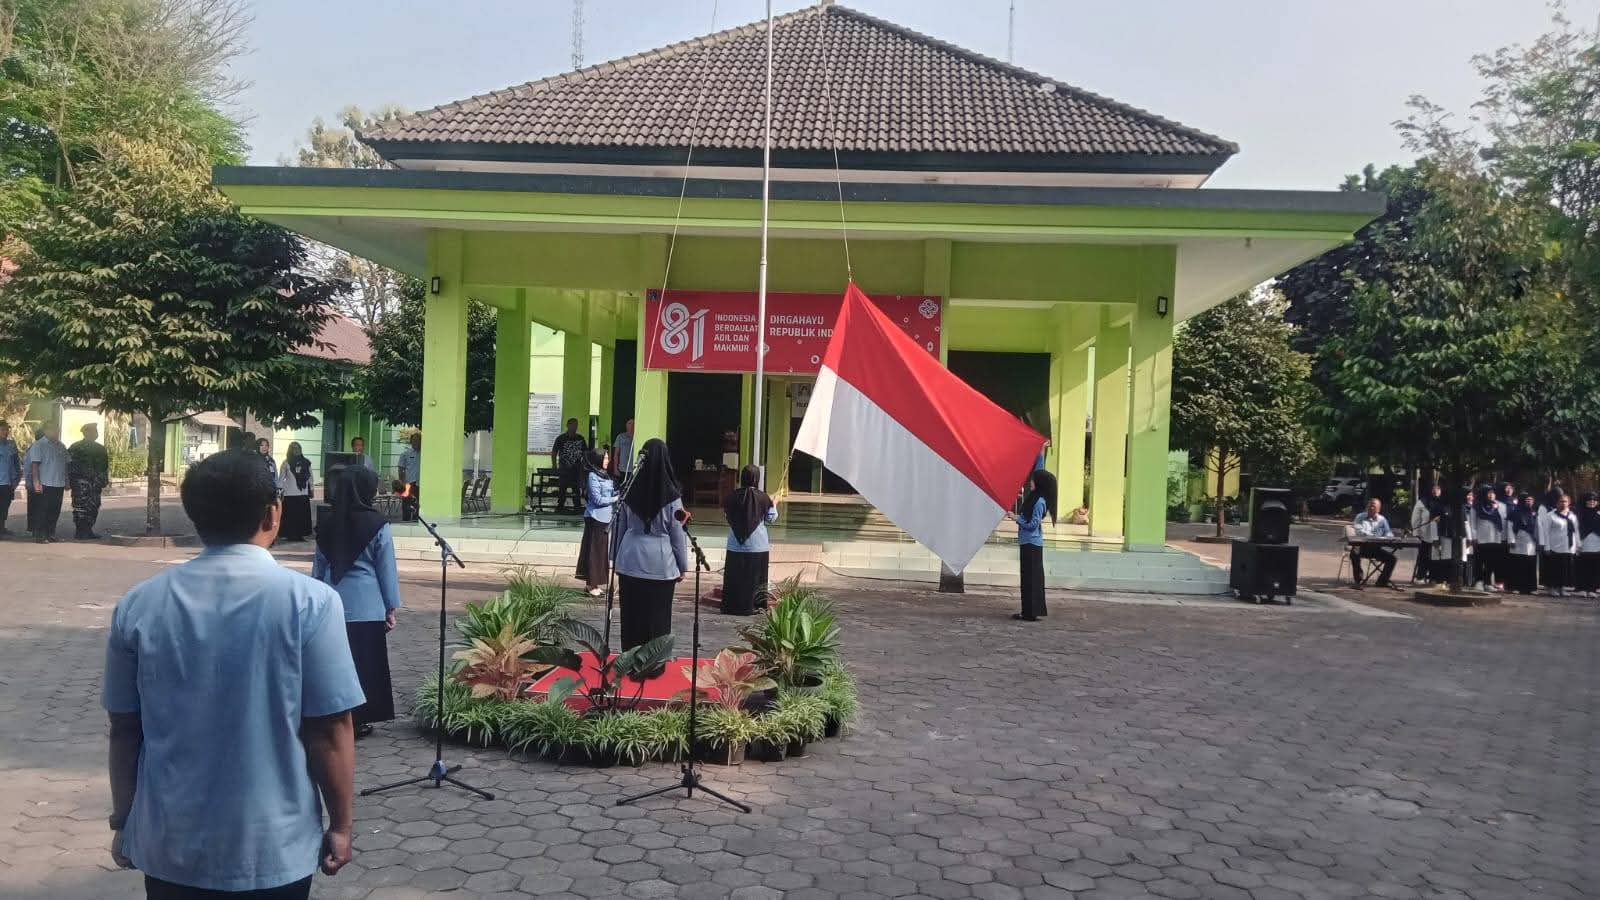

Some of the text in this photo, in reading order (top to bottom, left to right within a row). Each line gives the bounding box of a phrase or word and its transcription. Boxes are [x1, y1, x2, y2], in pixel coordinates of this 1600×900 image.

[714, 314, 756, 322] INDONESIA
[770, 315, 824, 325] DIRGAHAYU
[714, 324, 759, 332] BERDAULAT
[769, 327, 815, 337] REPUBLIK
[714, 334, 750, 342] ADIL DAN
[713, 344, 749, 352] MAKMUR
